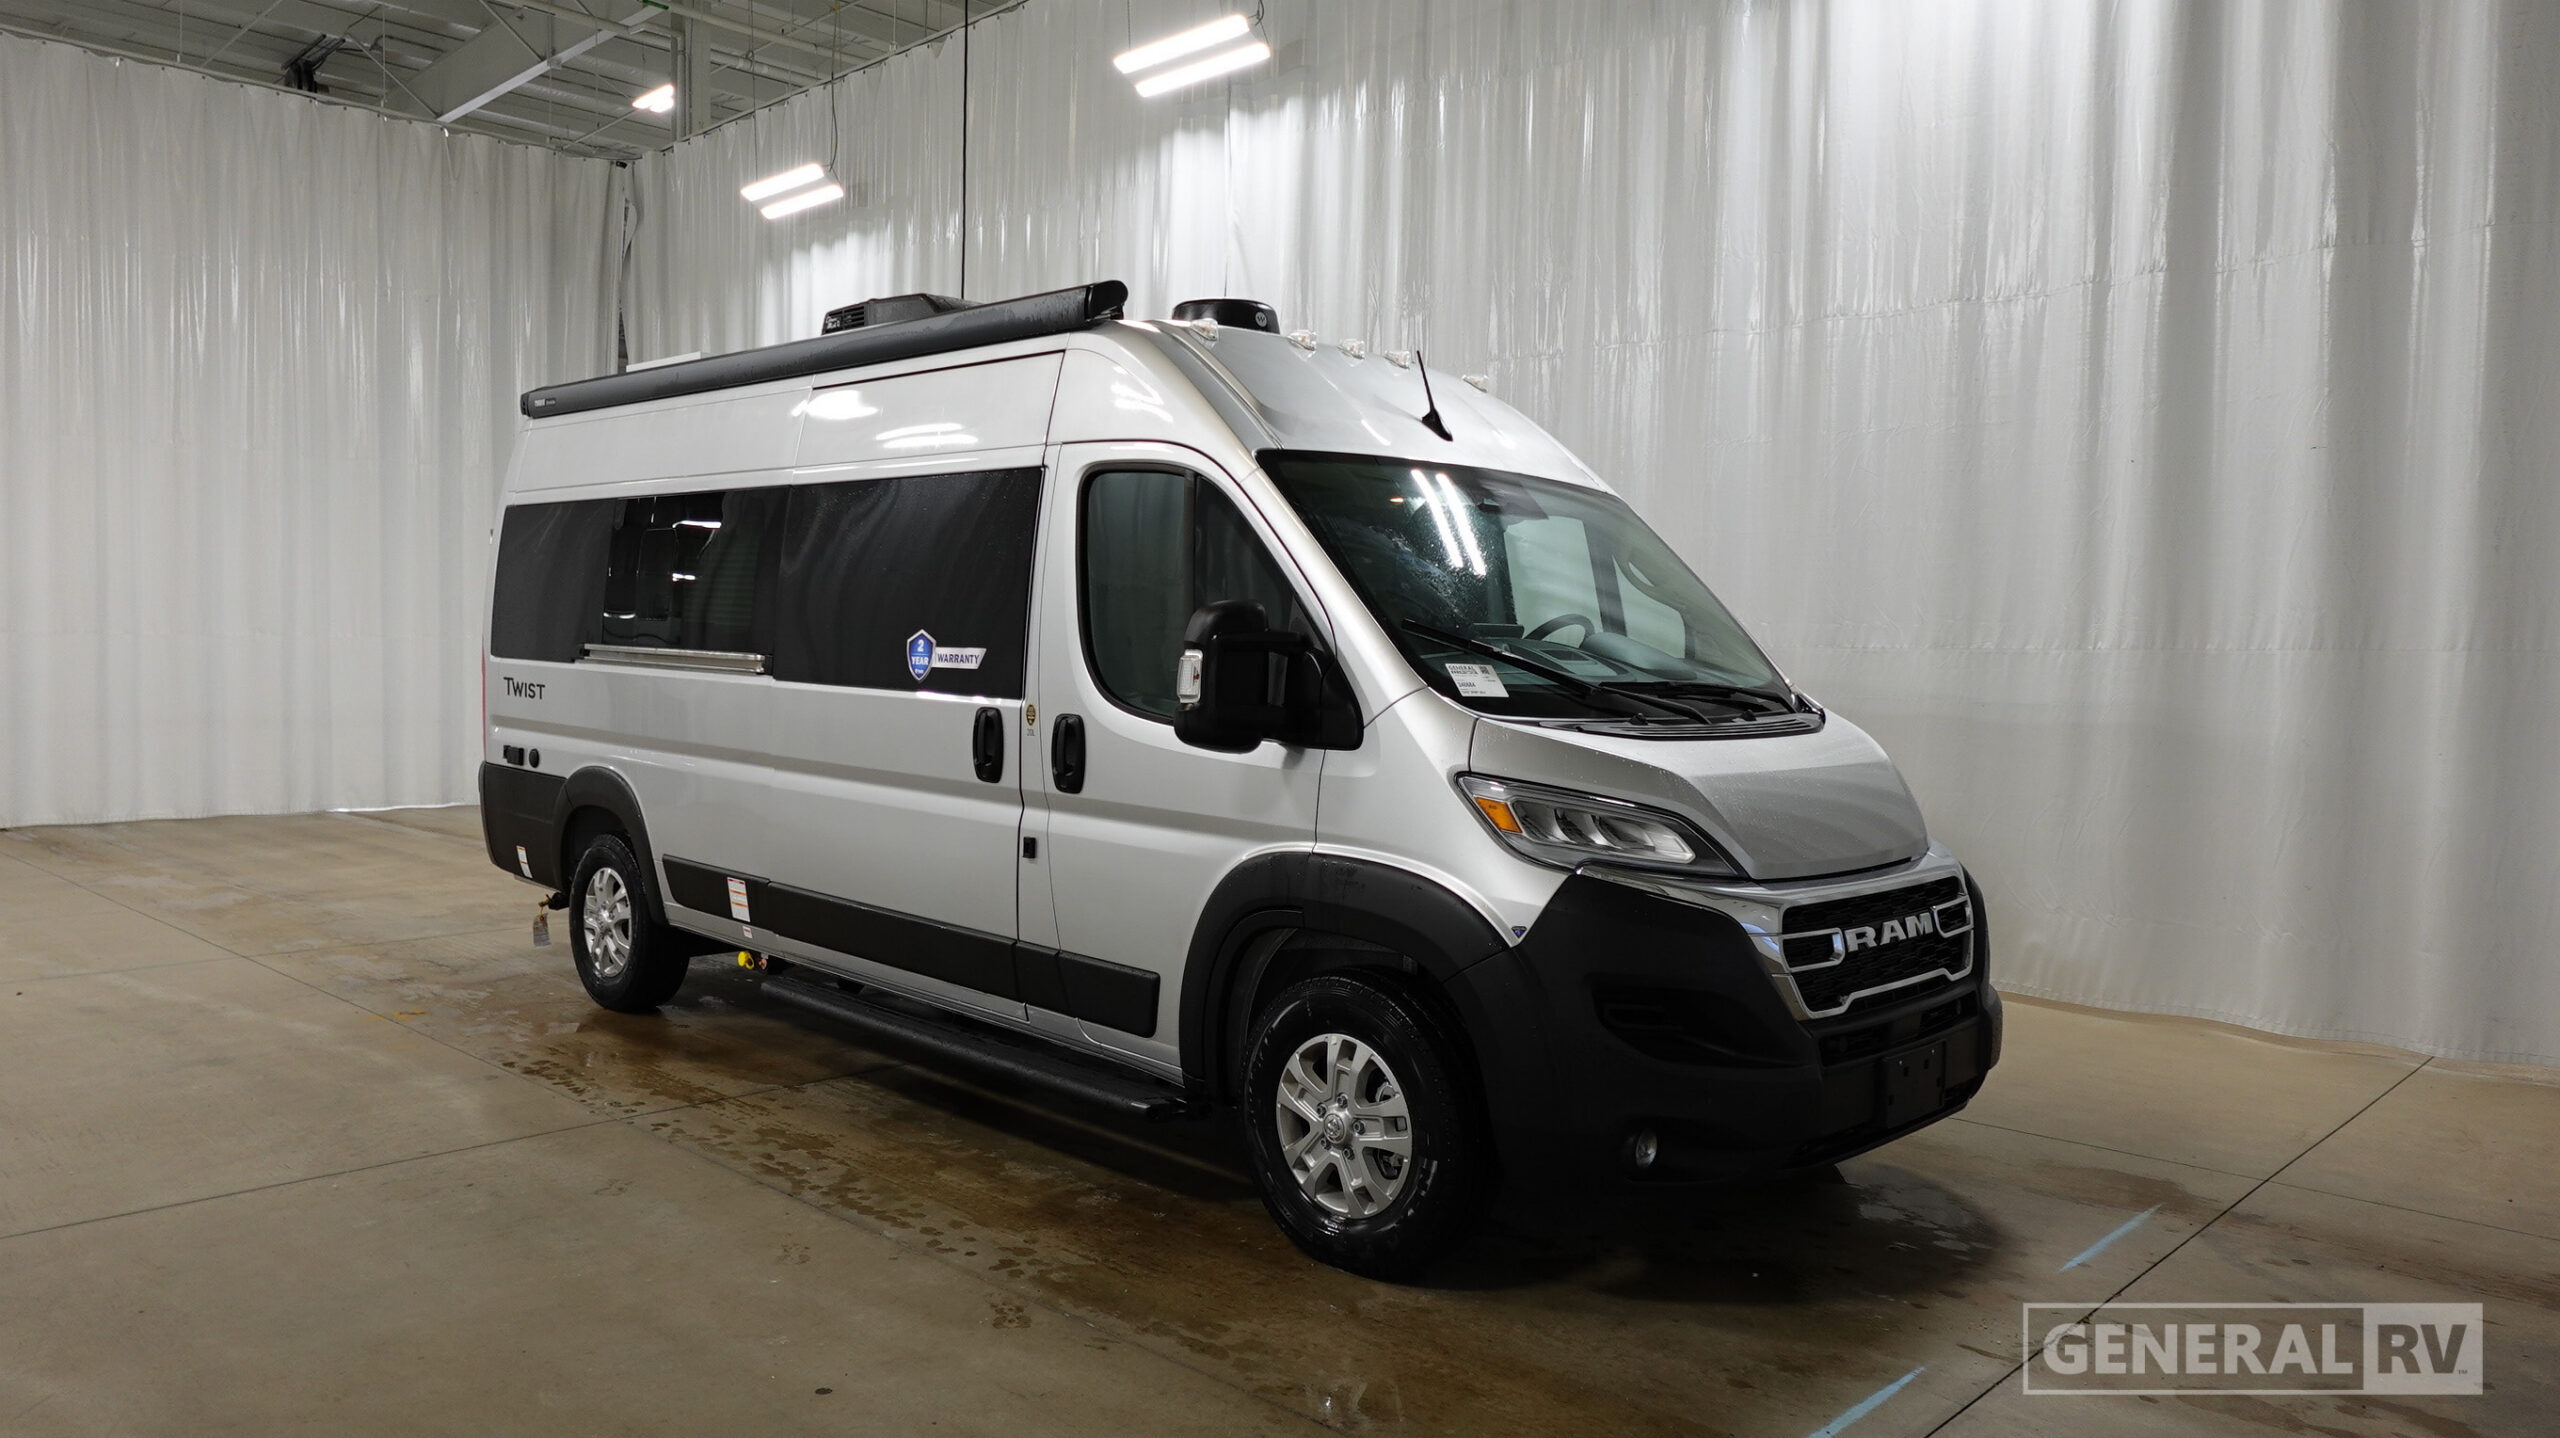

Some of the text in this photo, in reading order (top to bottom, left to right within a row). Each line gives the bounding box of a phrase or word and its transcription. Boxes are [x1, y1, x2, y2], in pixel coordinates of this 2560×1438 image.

[917, 639, 925, 652] 2
[911, 656, 929, 665] YEAR
[937, 653, 980, 664] WARRANTY
[1844, 912, 1934, 953] RAM
